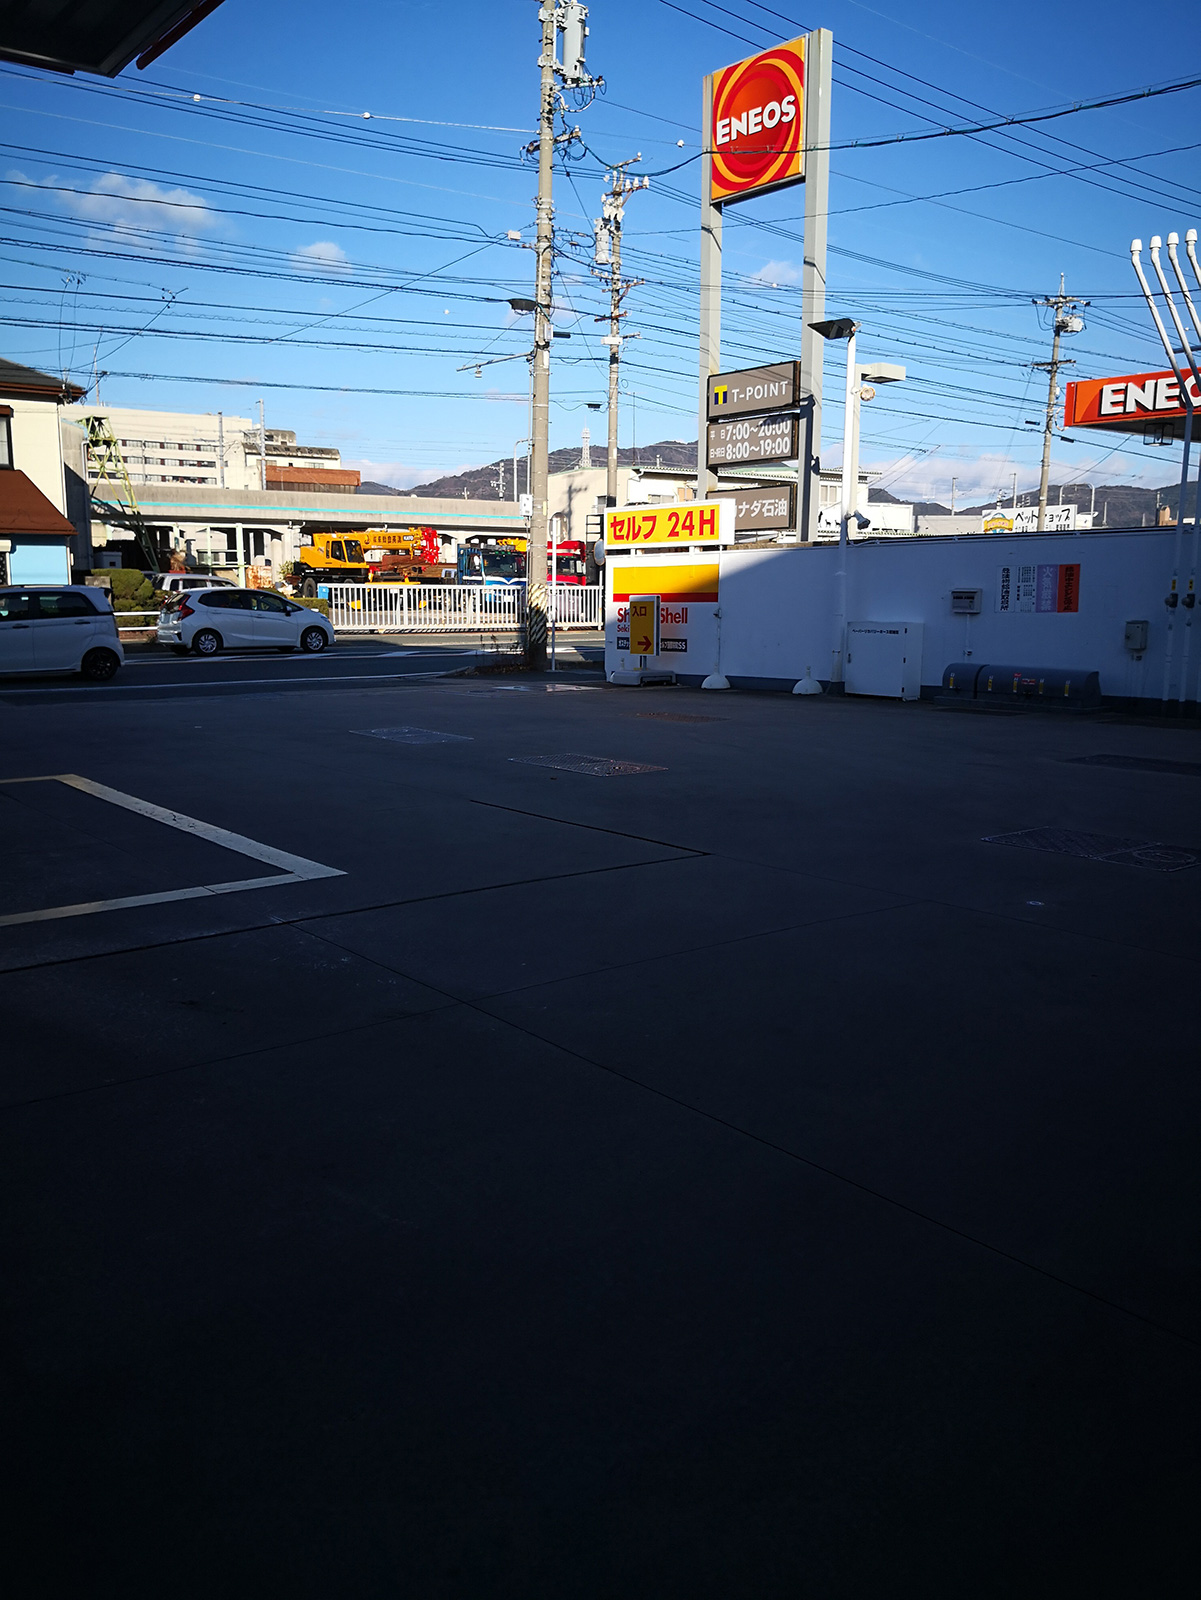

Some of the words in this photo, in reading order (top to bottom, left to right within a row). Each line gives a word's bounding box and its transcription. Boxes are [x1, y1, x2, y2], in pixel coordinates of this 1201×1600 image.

[716, 94, 796, 146] ENEOS
[732, 380, 789, 403] T-POINT
[735, 498, 788, 518] ナダ石油
[1015, 508, 1071, 525] ペットョップ
[610, 515, 657, 542] セルフ
[667, 508, 716, 538] 24H
[1041, 566, 1053, 611] 火気厳禁
[632, 606, 647, 617] 入口
[660, 607, 688, 624] Shell
[617, 624, 630, 633] Seki
